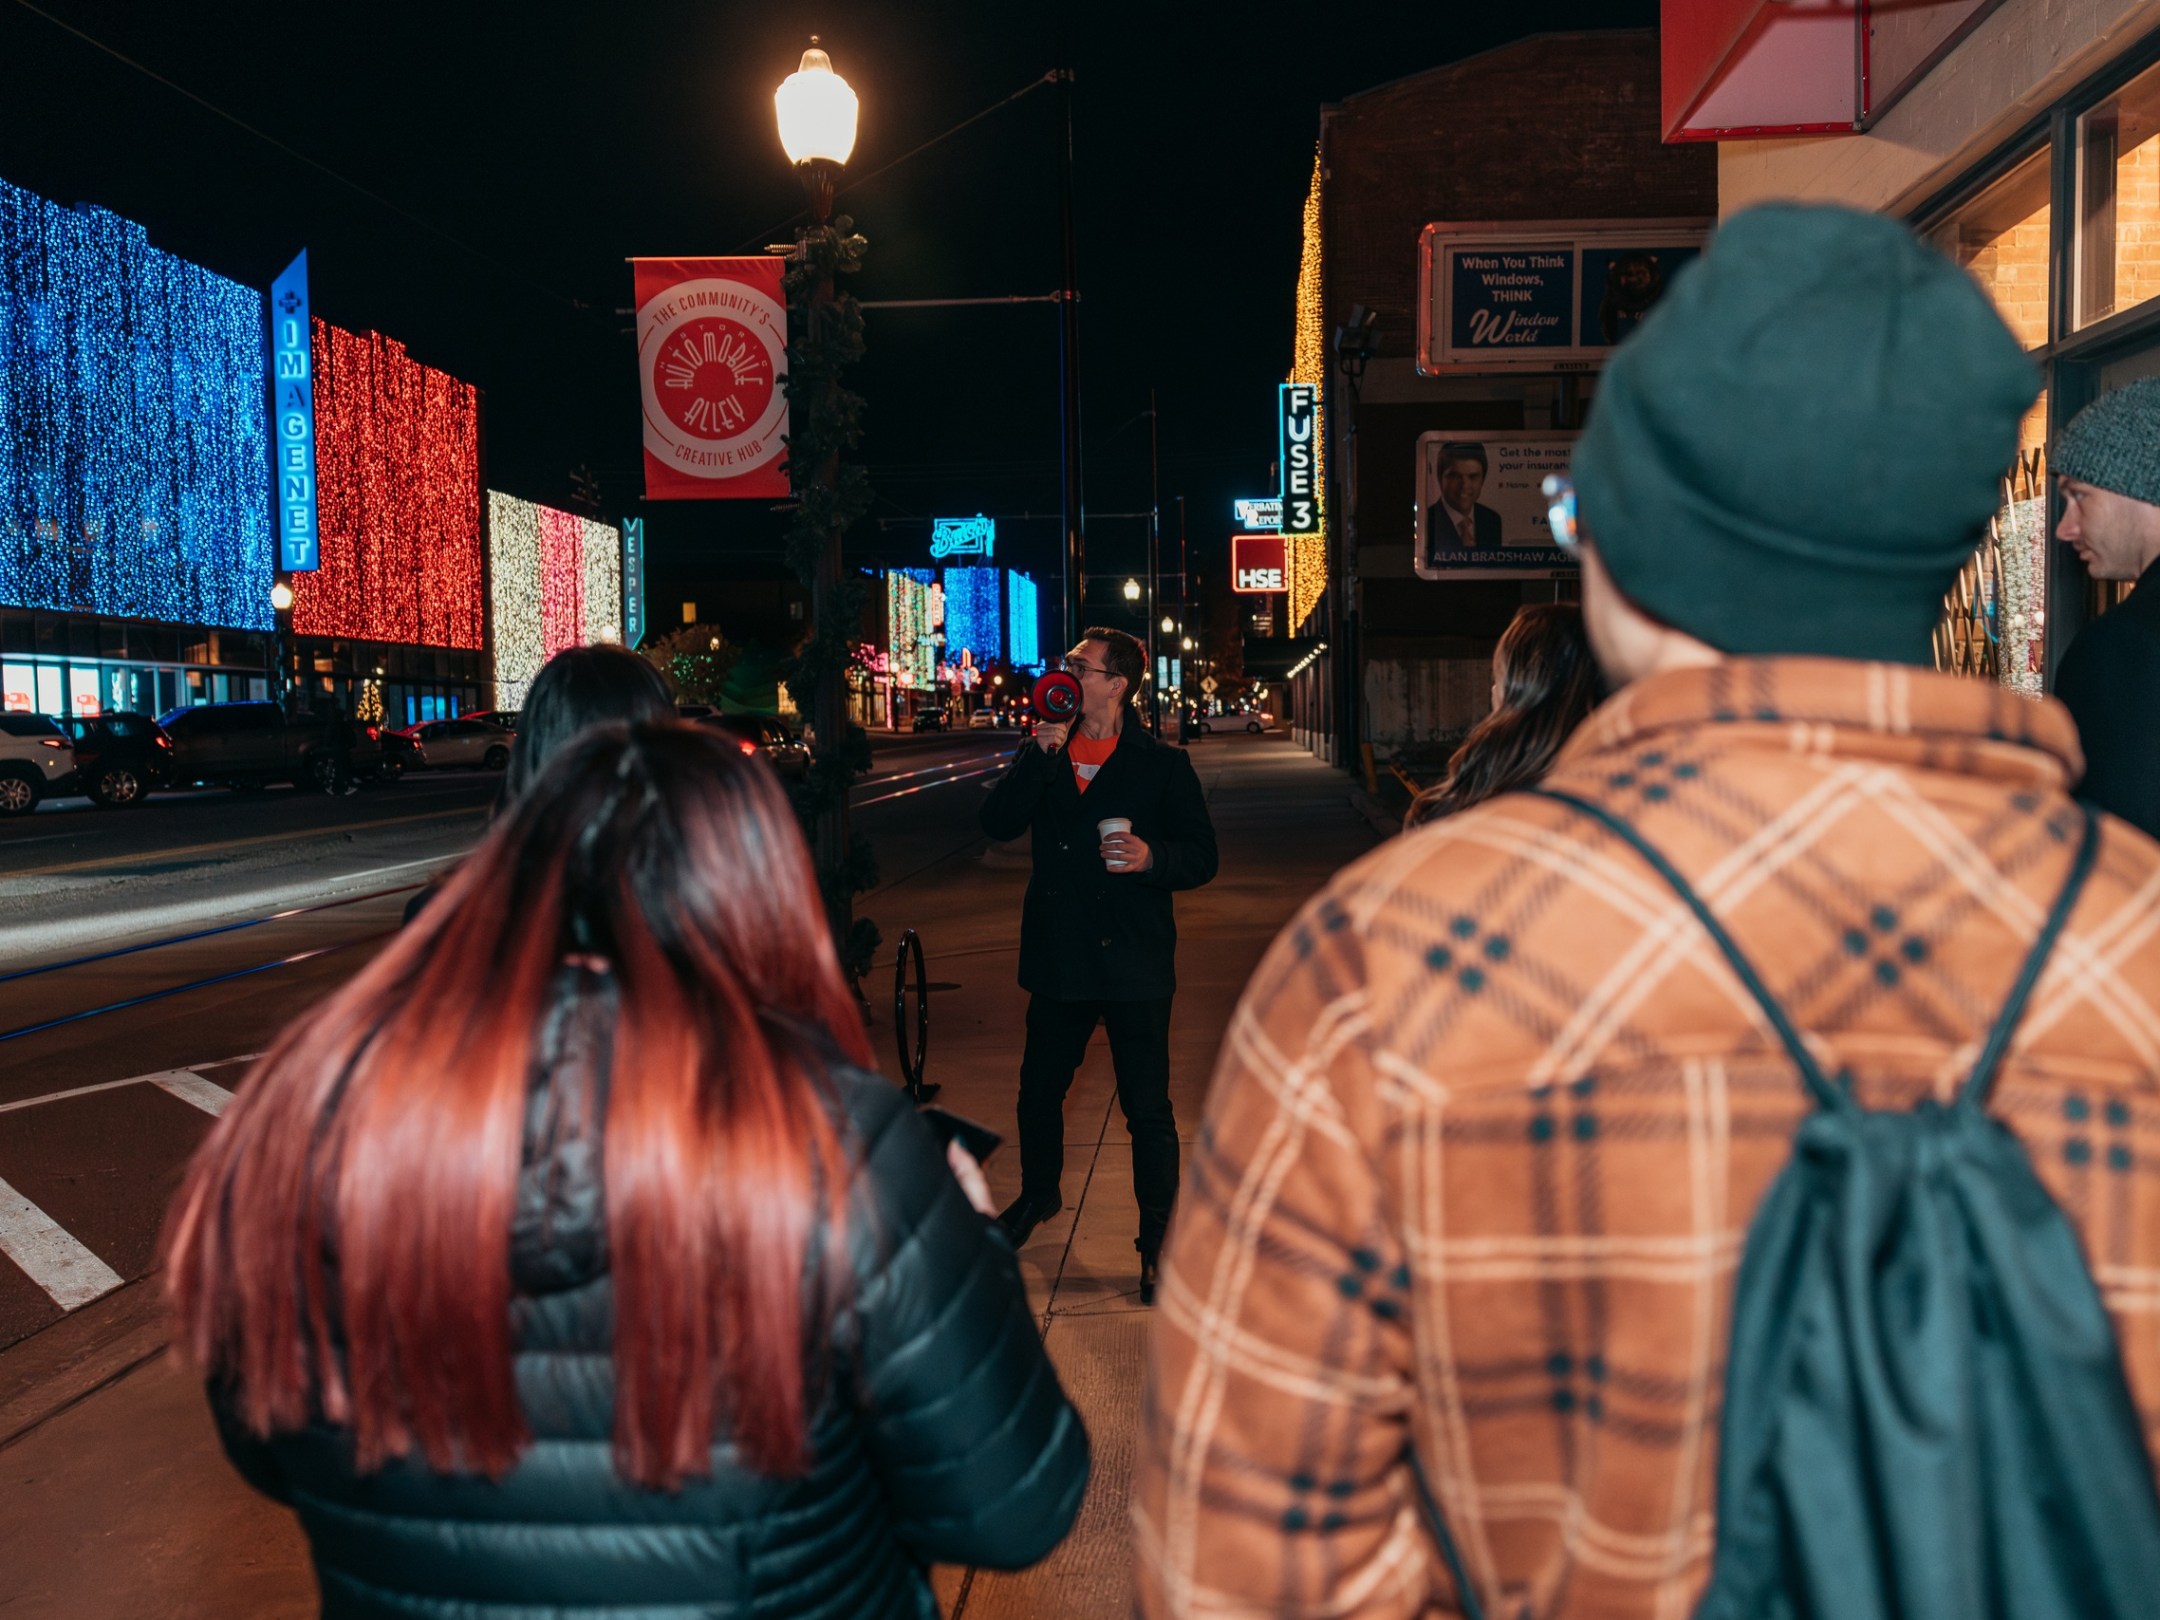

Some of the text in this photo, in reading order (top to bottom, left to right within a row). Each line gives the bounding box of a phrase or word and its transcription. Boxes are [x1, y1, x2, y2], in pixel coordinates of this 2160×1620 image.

[1462, 255, 1565, 269] When You Think
[1482, 273, 1544, 286] Windows,
[653, 291, 770, 326] THE COMMUNITY'S
[1492, 290, 1533, 302] THINK
[1469, 308, 1559, 344] Window
[665, 332, 763, 390] AUTOMOBILE
[684, 394, 746, 433] ALLEY
[278, 321, 310, 563] IMAGENET
[675, 440, 762, 466] CREATIVE HUB
[1499, 447, 1520, 458] Get
[1523, 447, 1542, 457] the
[1288, 389, 1312, 529] FUSE 3
[1498, 462, 1525, 472] your
[1433, 551, 1468, 562] ALAN
[1471, 550, 1544, 562] BRADSHAW
[623, 517, 639, 633] VESPER
[1239, 569, 1283, 588] HSE
